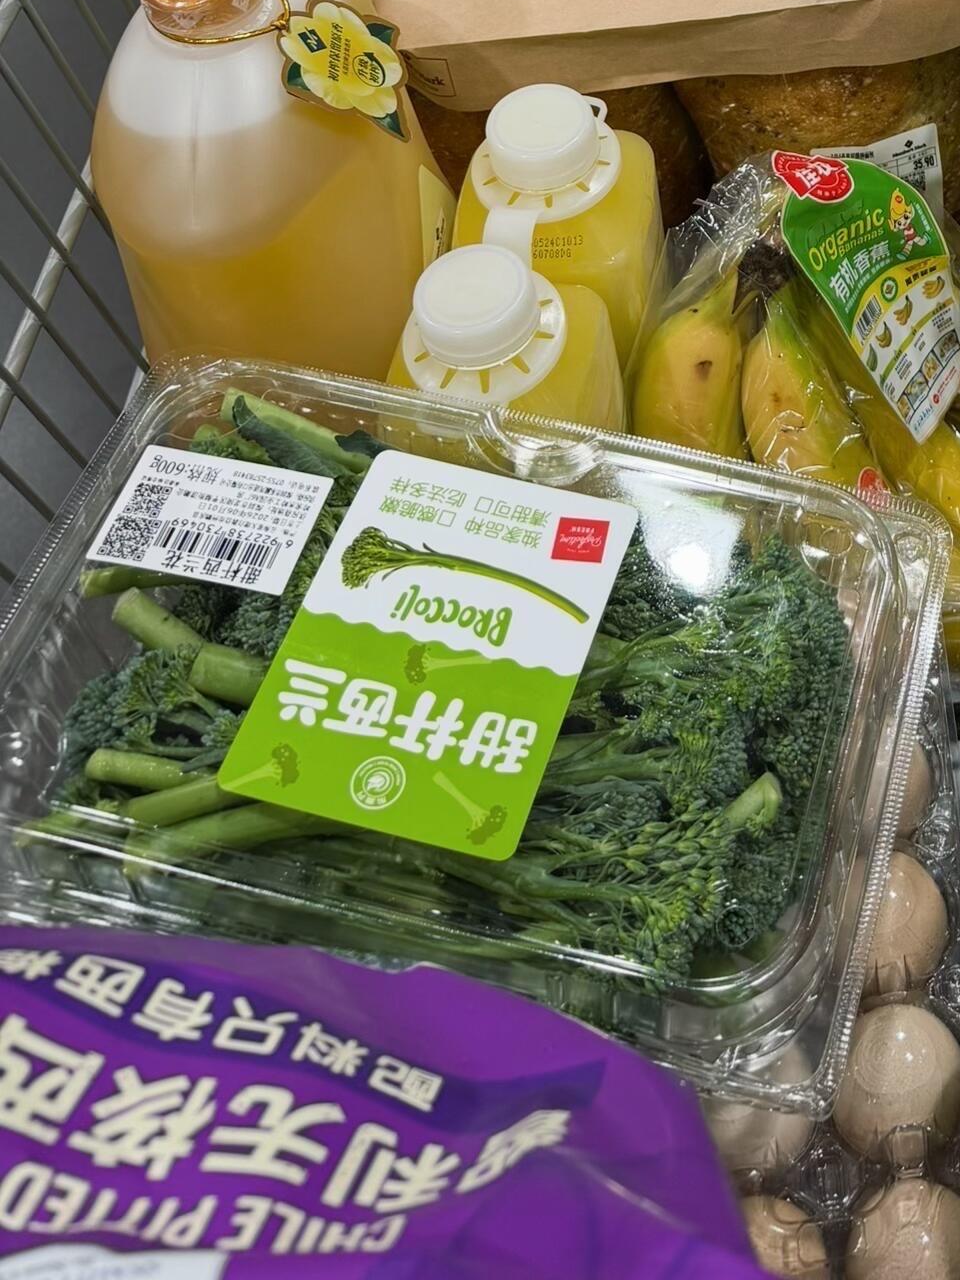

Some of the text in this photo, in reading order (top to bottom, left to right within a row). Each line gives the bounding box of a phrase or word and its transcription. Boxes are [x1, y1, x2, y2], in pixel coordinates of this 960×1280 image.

[913, 157, 935, 171] 35.90
[809, 207, 885, 271] Organic
[839, 227, 885, 255] Bananas
[828, 240, 890, 304] 有机香蕉
[150, 454, 224, 483] 规格:600g
[171, 519, 223, 533] 730469
[377, 494, 541, 550] 独家品种 口感脆嫩
[389, 475, 553, 528] 清甜可口 吃法多样
[228, 530, 277, 545] 922738
[278, 656, 540, 776] 甜杆西兰
[0, 1161, 407, 1256] CHILE PITTED
